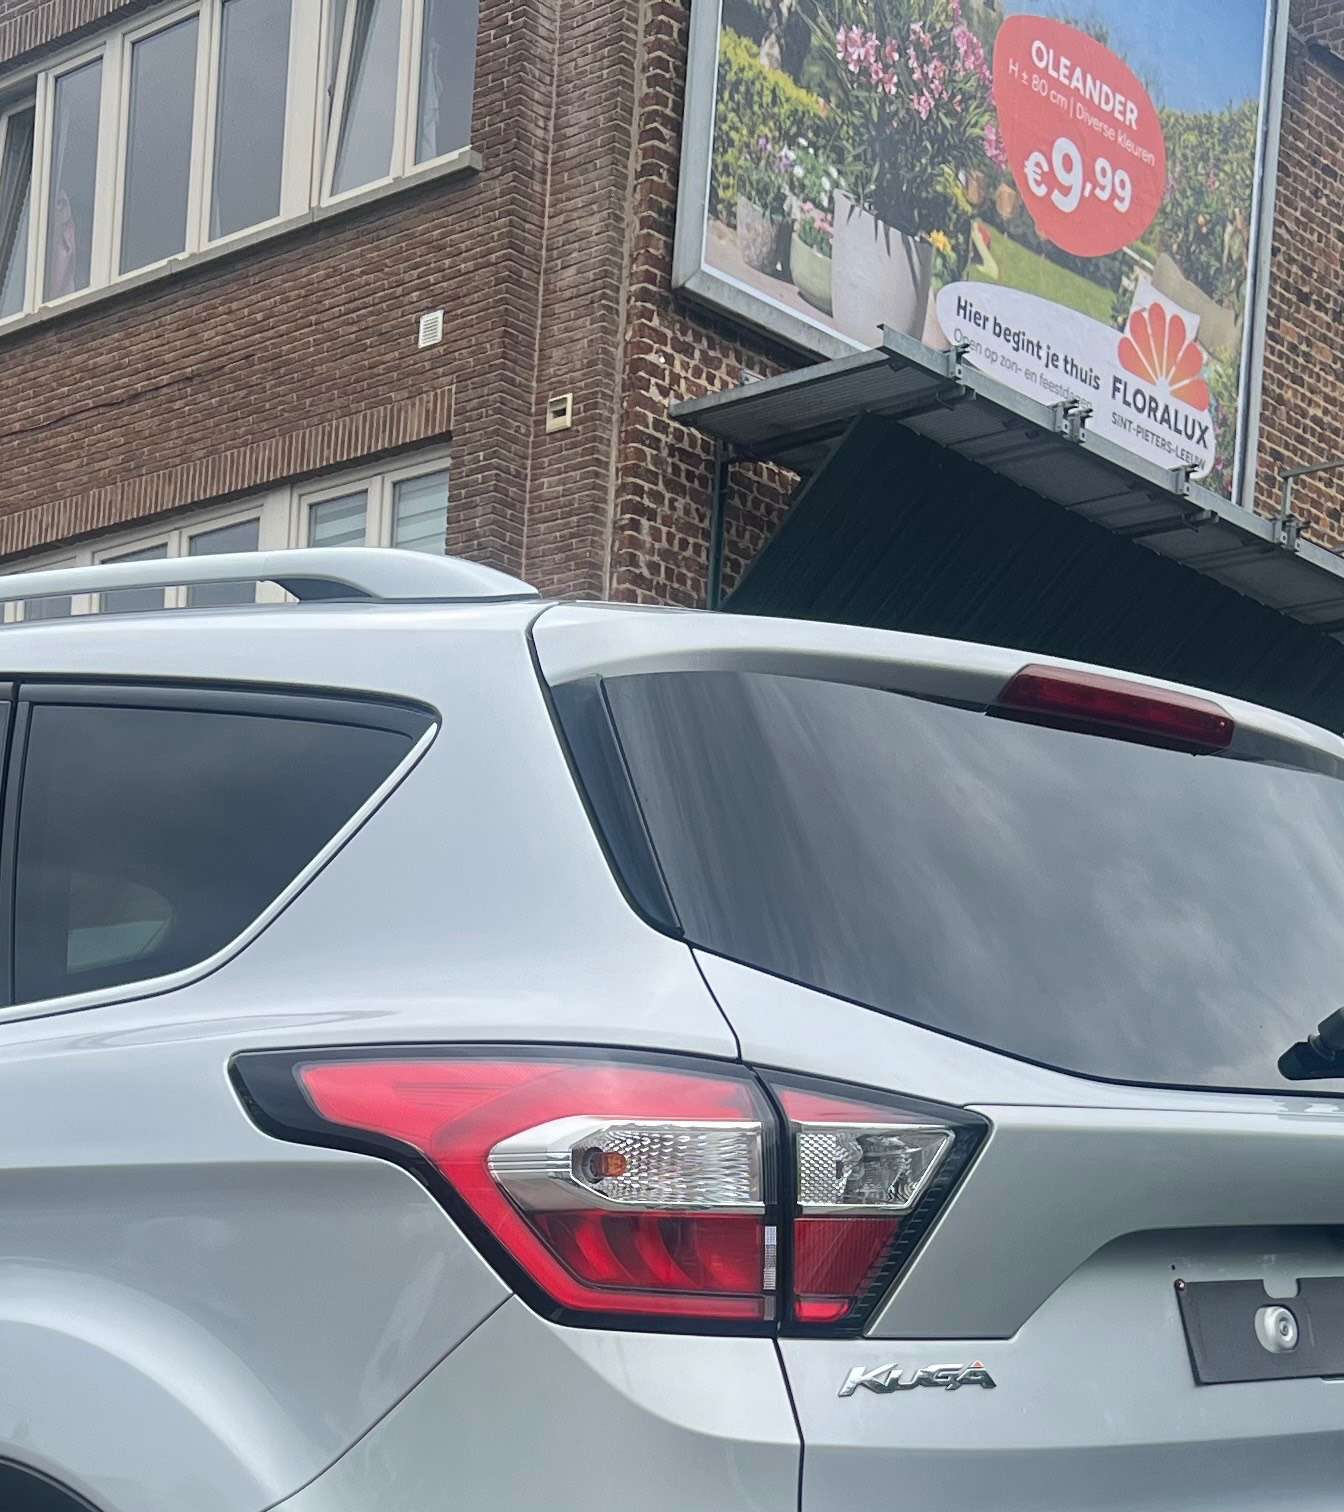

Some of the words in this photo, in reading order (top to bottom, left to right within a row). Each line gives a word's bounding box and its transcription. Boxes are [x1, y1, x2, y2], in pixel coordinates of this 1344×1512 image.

[1008, 58, 1019, 79] H
[1031, 74, 1049, 97] 80
[1049, 90, 1068, 112] cm
[1076, 103, 1116, 141] Diverse
[1117, 129, 1156, 167] kleuren
[1031, 40, 1138, 130] OLEANDER
[1023, 137, 1132, 214] €9,99
[956, 295, 989, 331] Hier
[992, 316, 1042, 361] begint
[1045, 344, 1059, 369] je
[1063, 353, 1101, 391] thuis
[984, 346, 999, 365] op
[1024, 368, 1038, 384] en
[1111, 375, 1209, 450] FLORALUX
[837, 1359, 997, 1399] KUGA
